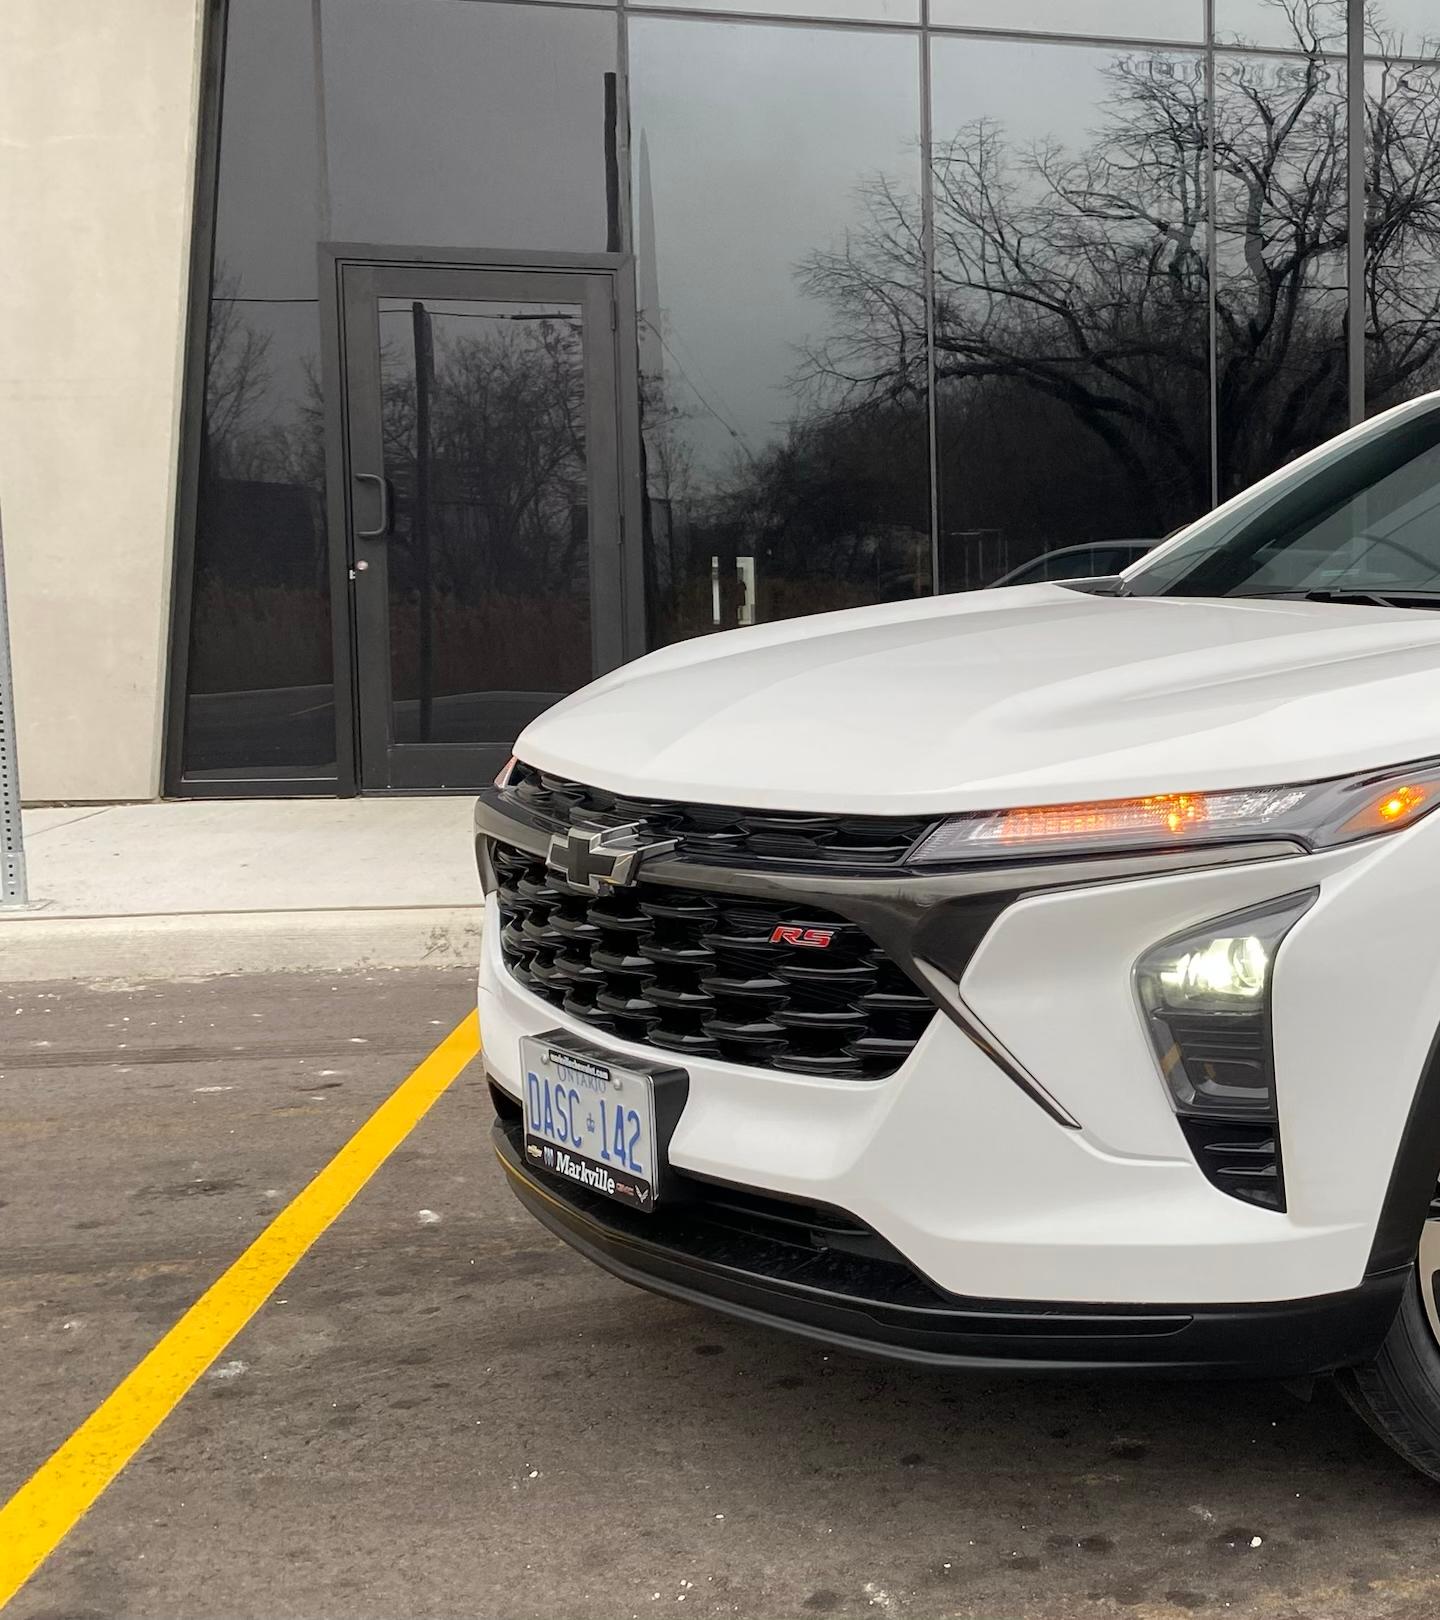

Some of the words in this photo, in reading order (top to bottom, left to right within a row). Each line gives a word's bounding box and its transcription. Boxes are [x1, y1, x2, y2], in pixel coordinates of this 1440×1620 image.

[770, 925, 835, 948] RS
[527, 1071, 582, 1149] DASC
[599, 1099, 643, 1174] 142
[555, 1150, 616, 1195] Markville
